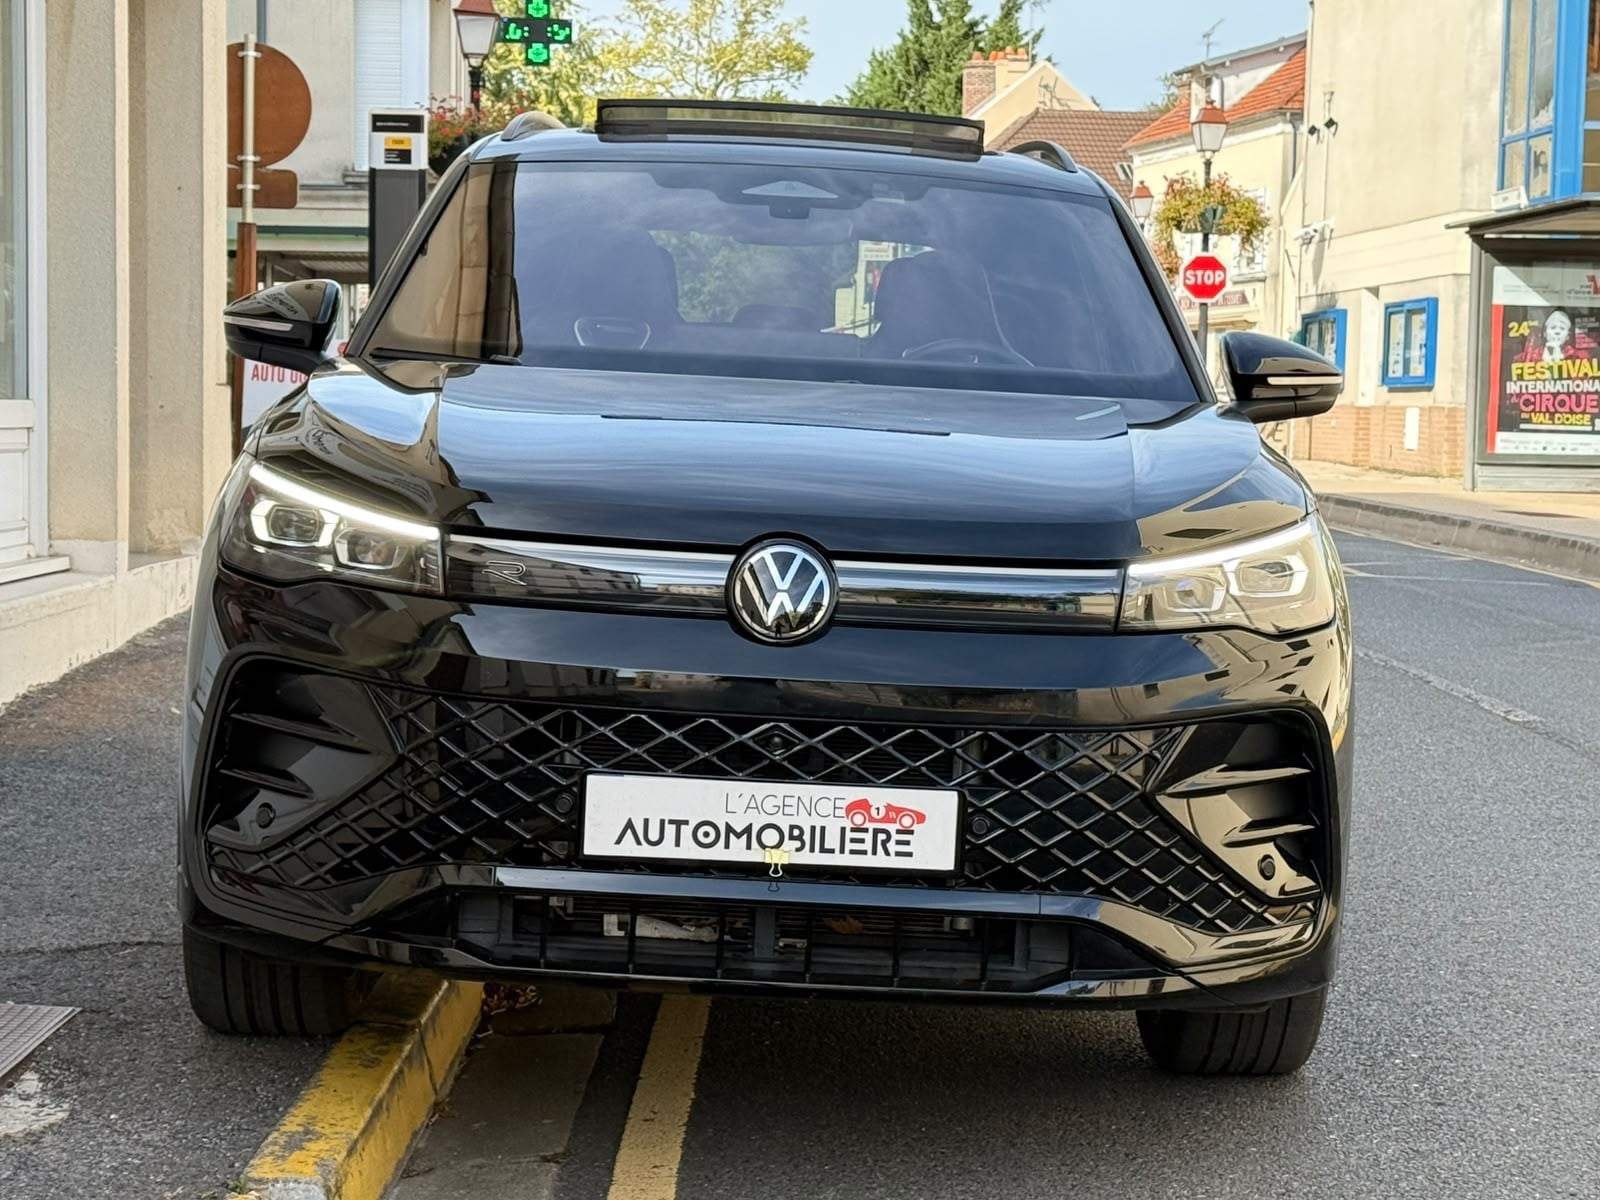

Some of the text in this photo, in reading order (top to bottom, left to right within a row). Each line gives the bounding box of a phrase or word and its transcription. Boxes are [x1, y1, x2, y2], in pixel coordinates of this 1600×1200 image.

[1184, 269, 1225, 286] STOP
[1511, 358, 1600, 381] FESTIVAL
[1519, 394, 1599, 413] CIRQUE
[1531, 412, 1553, 424] VAL
[1554, 413, 1592, 425] D'OISE
[724, 792, 846, 819] L'AGENCE
[874, 806, 881, 817] 1
[613, 817, 915, 858] AUTOMOBILIERE
